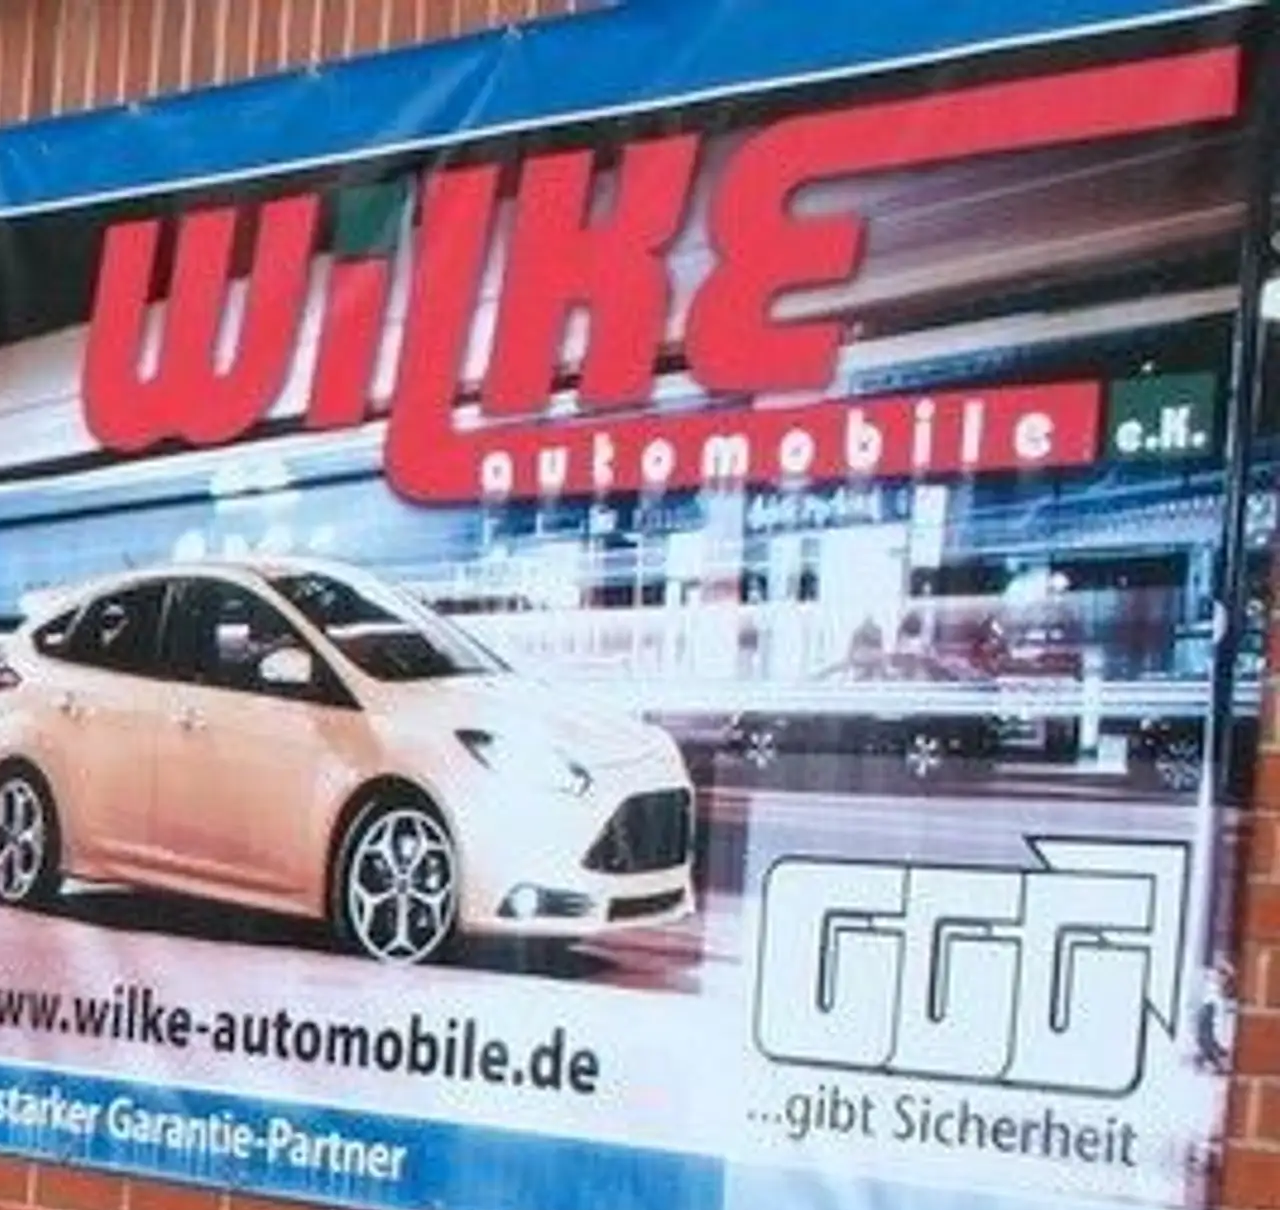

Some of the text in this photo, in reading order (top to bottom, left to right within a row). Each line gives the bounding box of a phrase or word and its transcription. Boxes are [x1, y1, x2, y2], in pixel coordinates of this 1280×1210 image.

[480, 396, 1053, 494] automobile
[107, 1095, 408, 1182] Garantie-Partner
[892, 1094, 1140, 1168] Sicherheit
